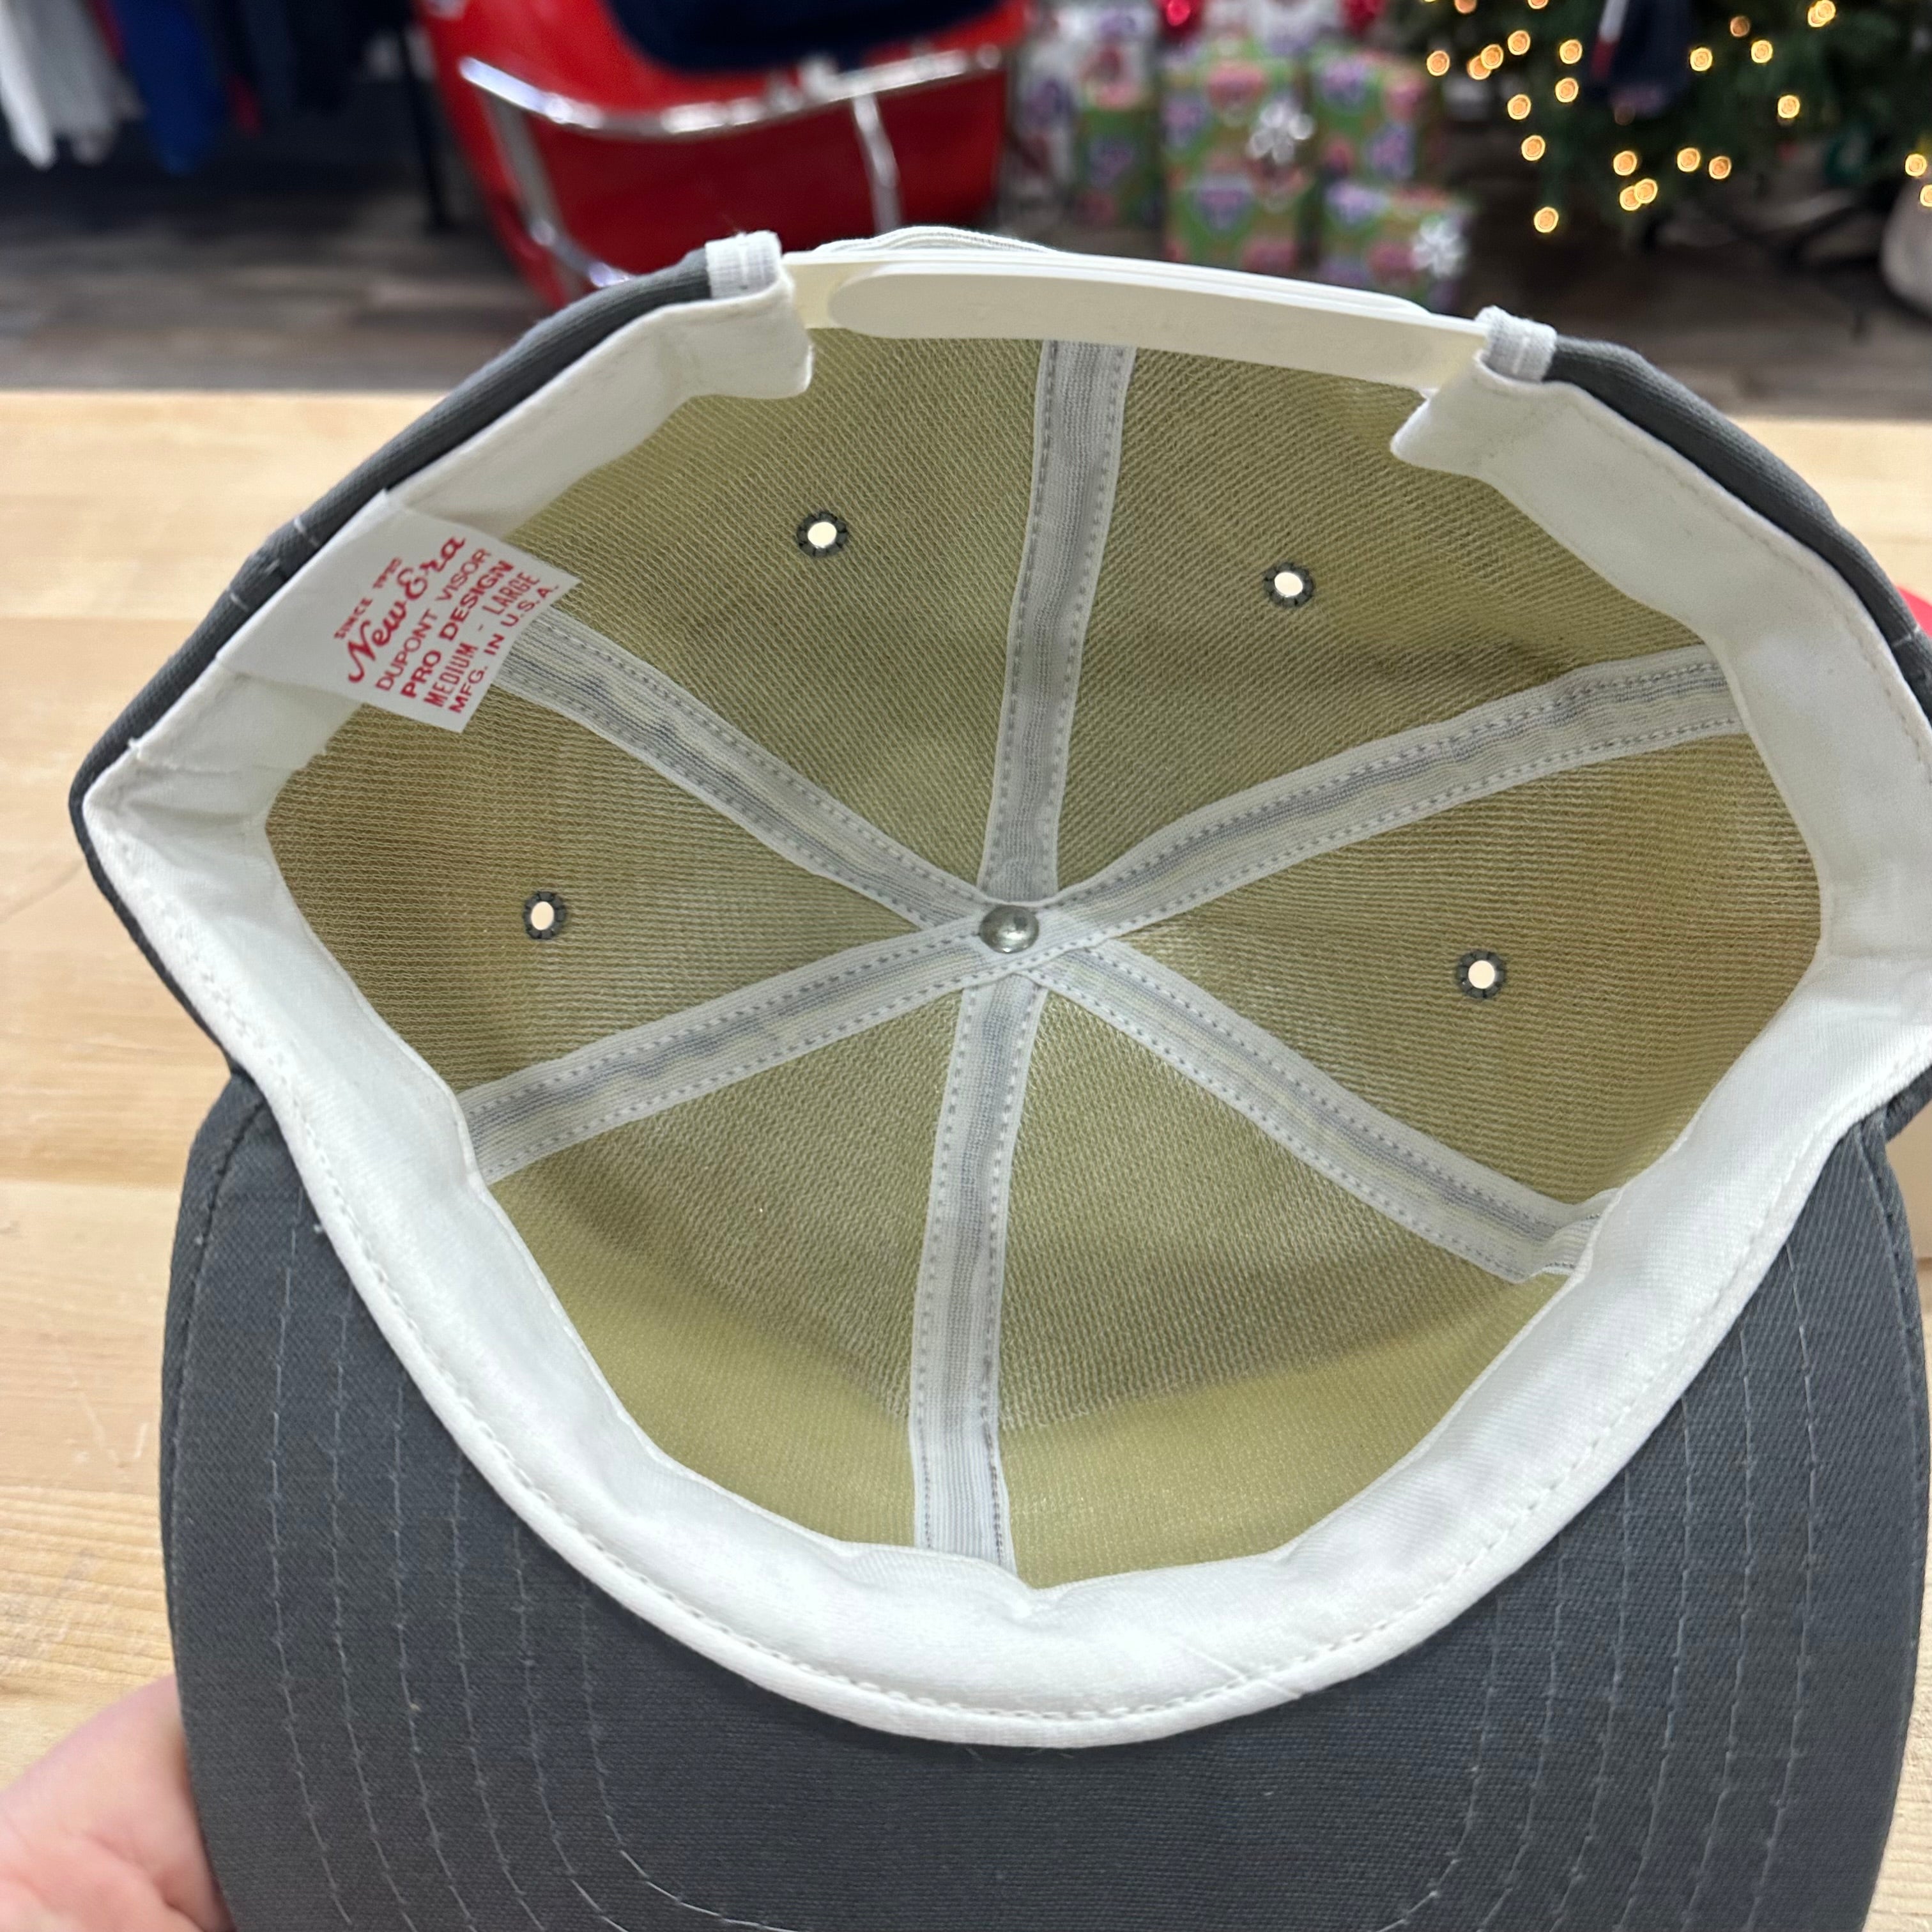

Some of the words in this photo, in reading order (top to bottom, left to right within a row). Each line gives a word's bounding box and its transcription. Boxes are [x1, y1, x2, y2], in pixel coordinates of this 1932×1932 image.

[347, 599, 407, 683] New
[396, 537, 466, 601] Era
[375, 609, 438, 691] DUPONT
[434, 548, 491, 602] VISOR
[400, 649, 442, 698] PRO
[438, 560, 515, 641] DESIGN
[423, 641, 479, 707] MEDIUM
[482, 572, 540, 615] LARGE
[448, 666, 489, 714] MFG.
[484, 634, 505, 656] IN
[500, 584, 560, 627] U.S.A.
